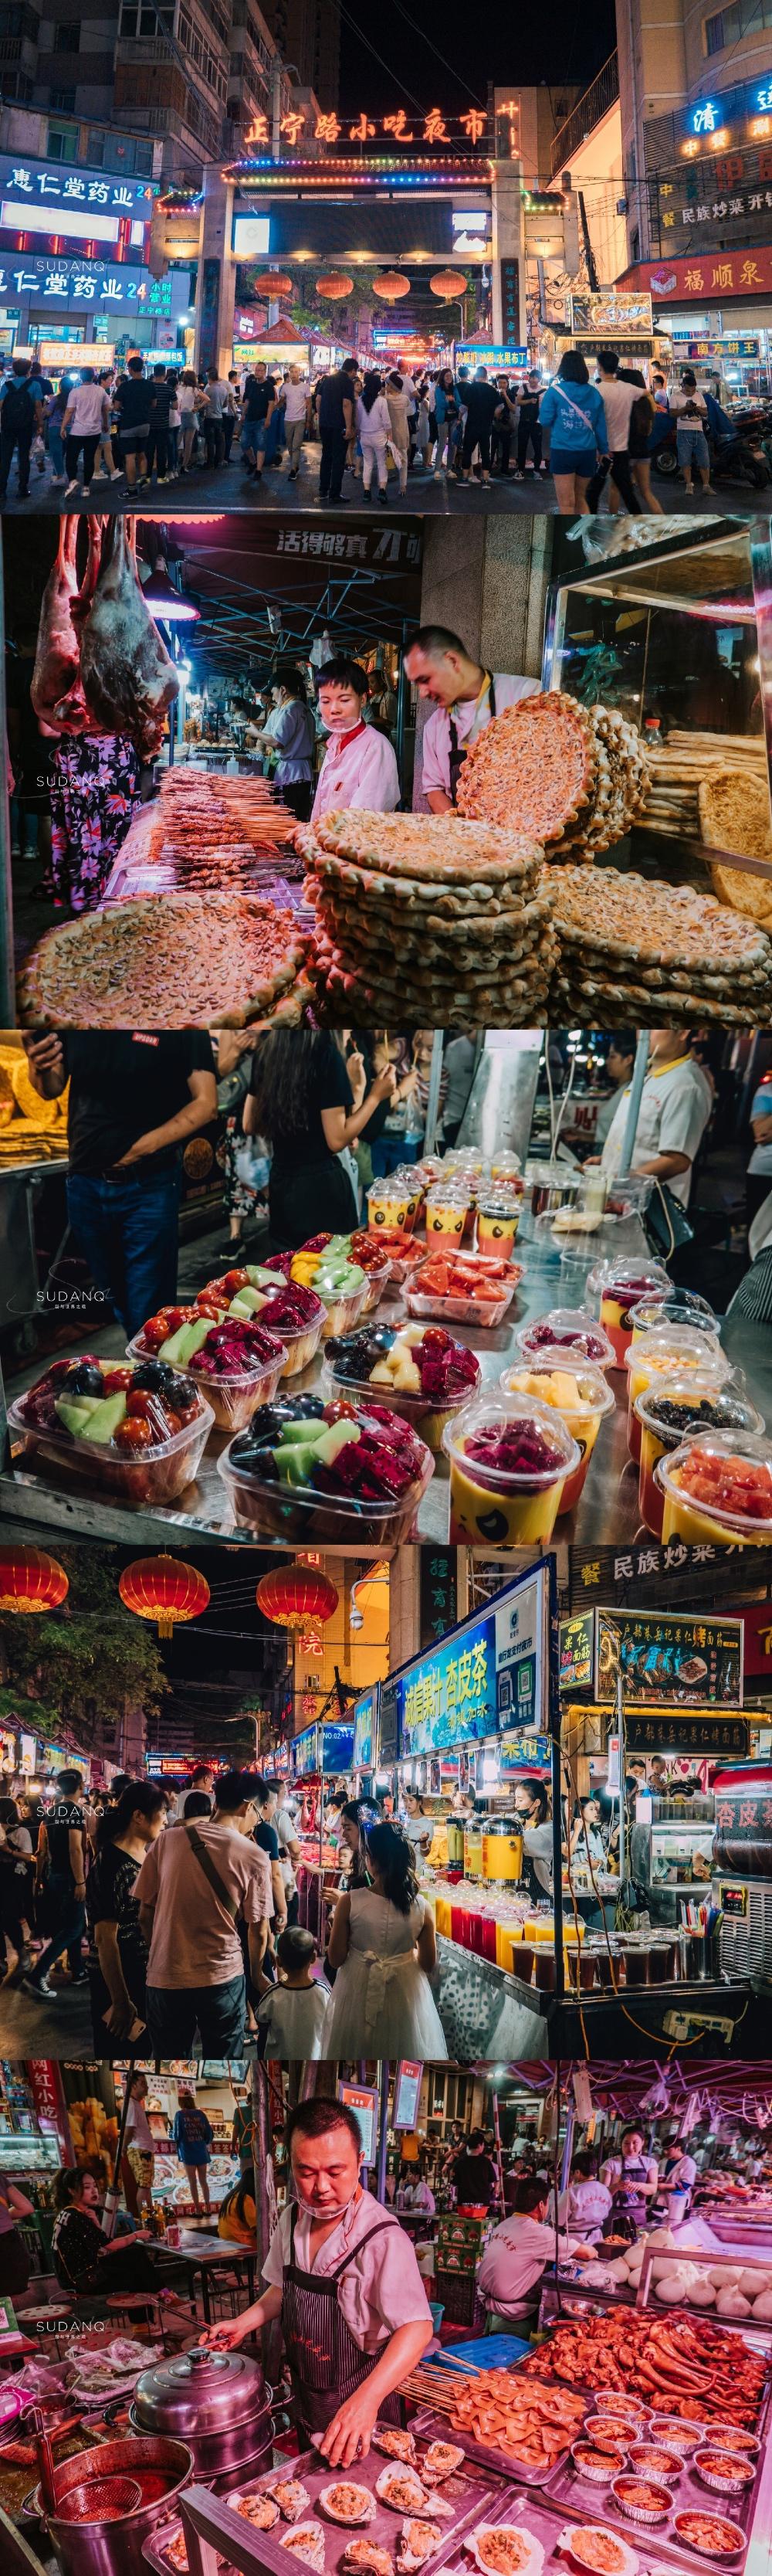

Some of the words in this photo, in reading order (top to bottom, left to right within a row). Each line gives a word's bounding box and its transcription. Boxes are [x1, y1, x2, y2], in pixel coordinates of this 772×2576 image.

[245, 108, 487, 145] 正宁路小吃夜市
[6, 168, 134, 208] 惠仁堂药业
[682, 198, 745, 225] 民族炒菜
[127, 283, 147, 300] 24
[684, 260, 764, 292] 福顺泉
[497, 351, 527, 365] 水果布丁
[696, 341, 755, 355] 南方饼王
[581, 1563, 601, 1587] 餐
[614, 1545, 716, 1580] 民族炒菜
[445, 1638, 487, 1711] 杏皮茶
[32, 2060, 58, 2119] 网红小吃
